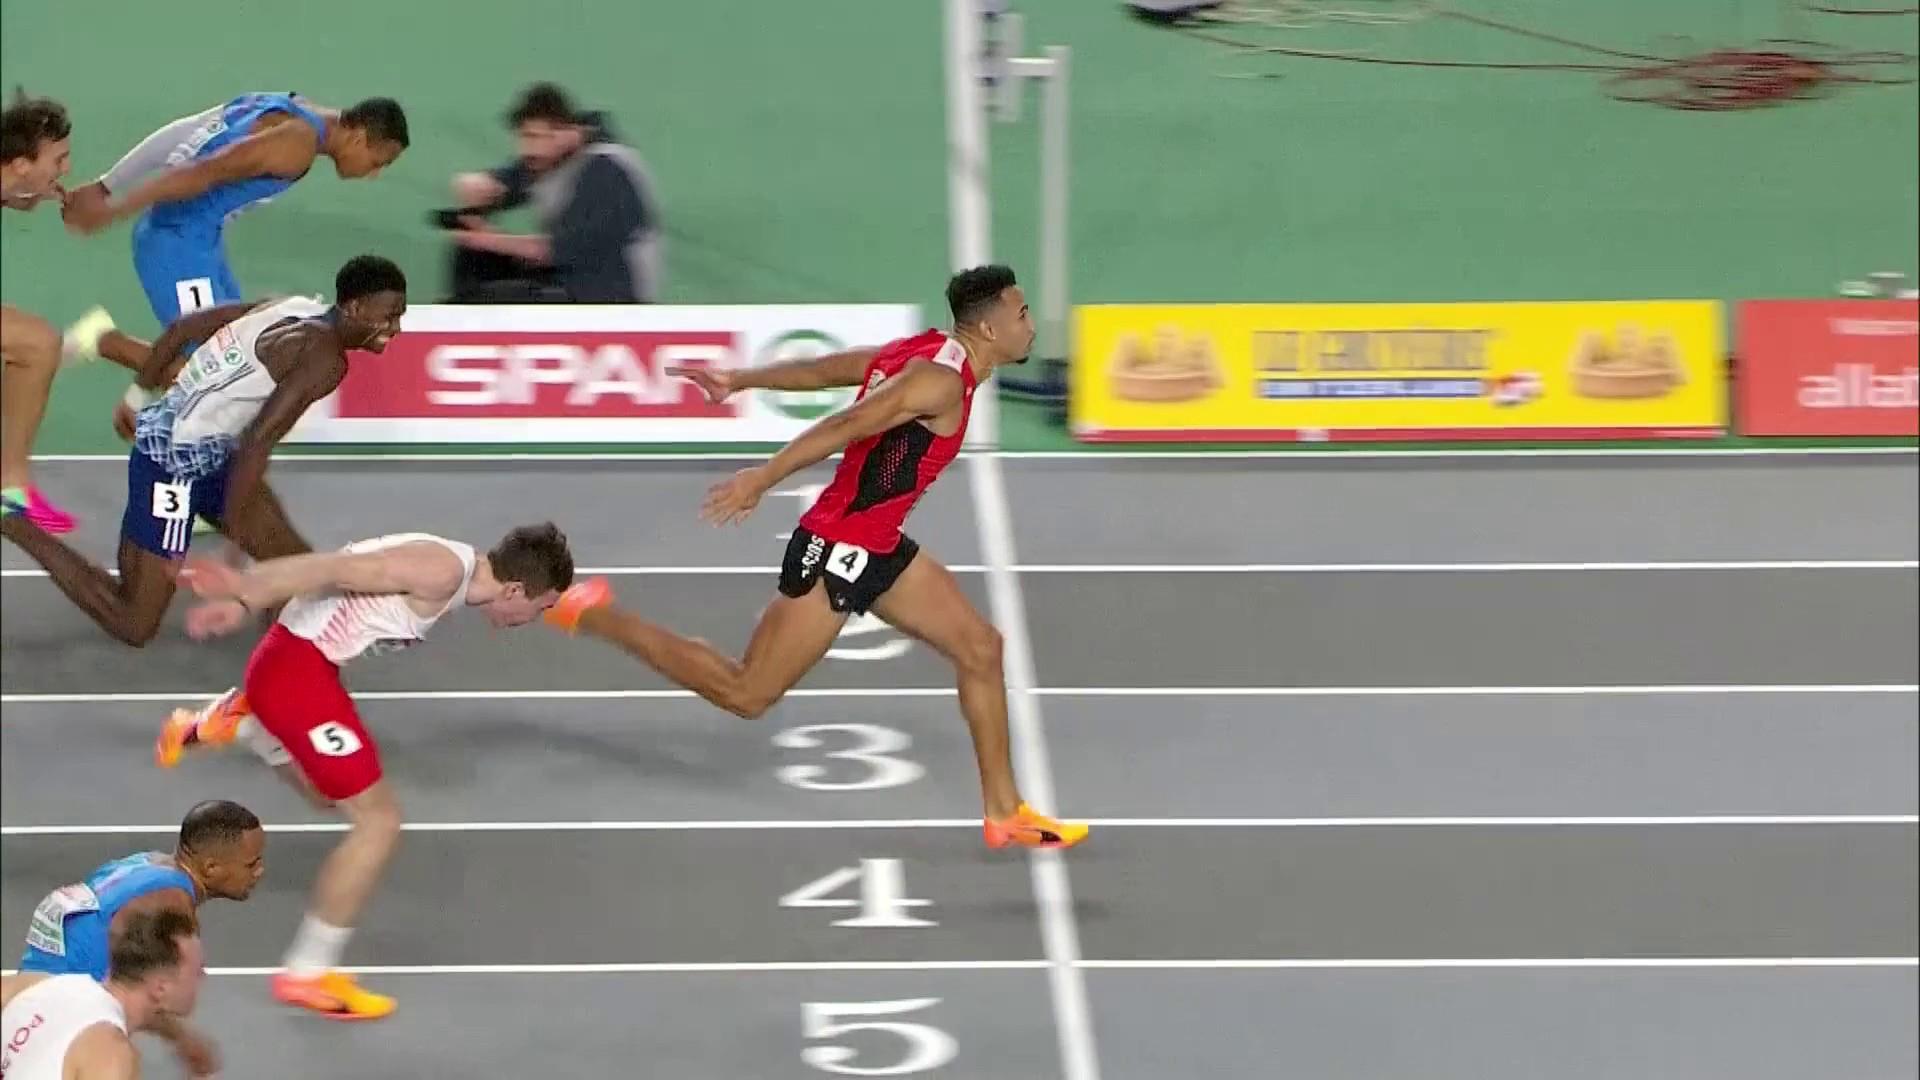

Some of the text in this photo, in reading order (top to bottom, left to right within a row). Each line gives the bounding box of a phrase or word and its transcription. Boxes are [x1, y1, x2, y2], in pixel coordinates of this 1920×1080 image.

[189, 285, 201, 308] 1
[164, 490, 181, 513] 3
[839, 550, 859, 574] 4
[324, 727, 345, 752] 5
[771, 723, 926, 790] 3
[778, 858, 940, 927] 4
[800, 998, 960, 1075] 5
